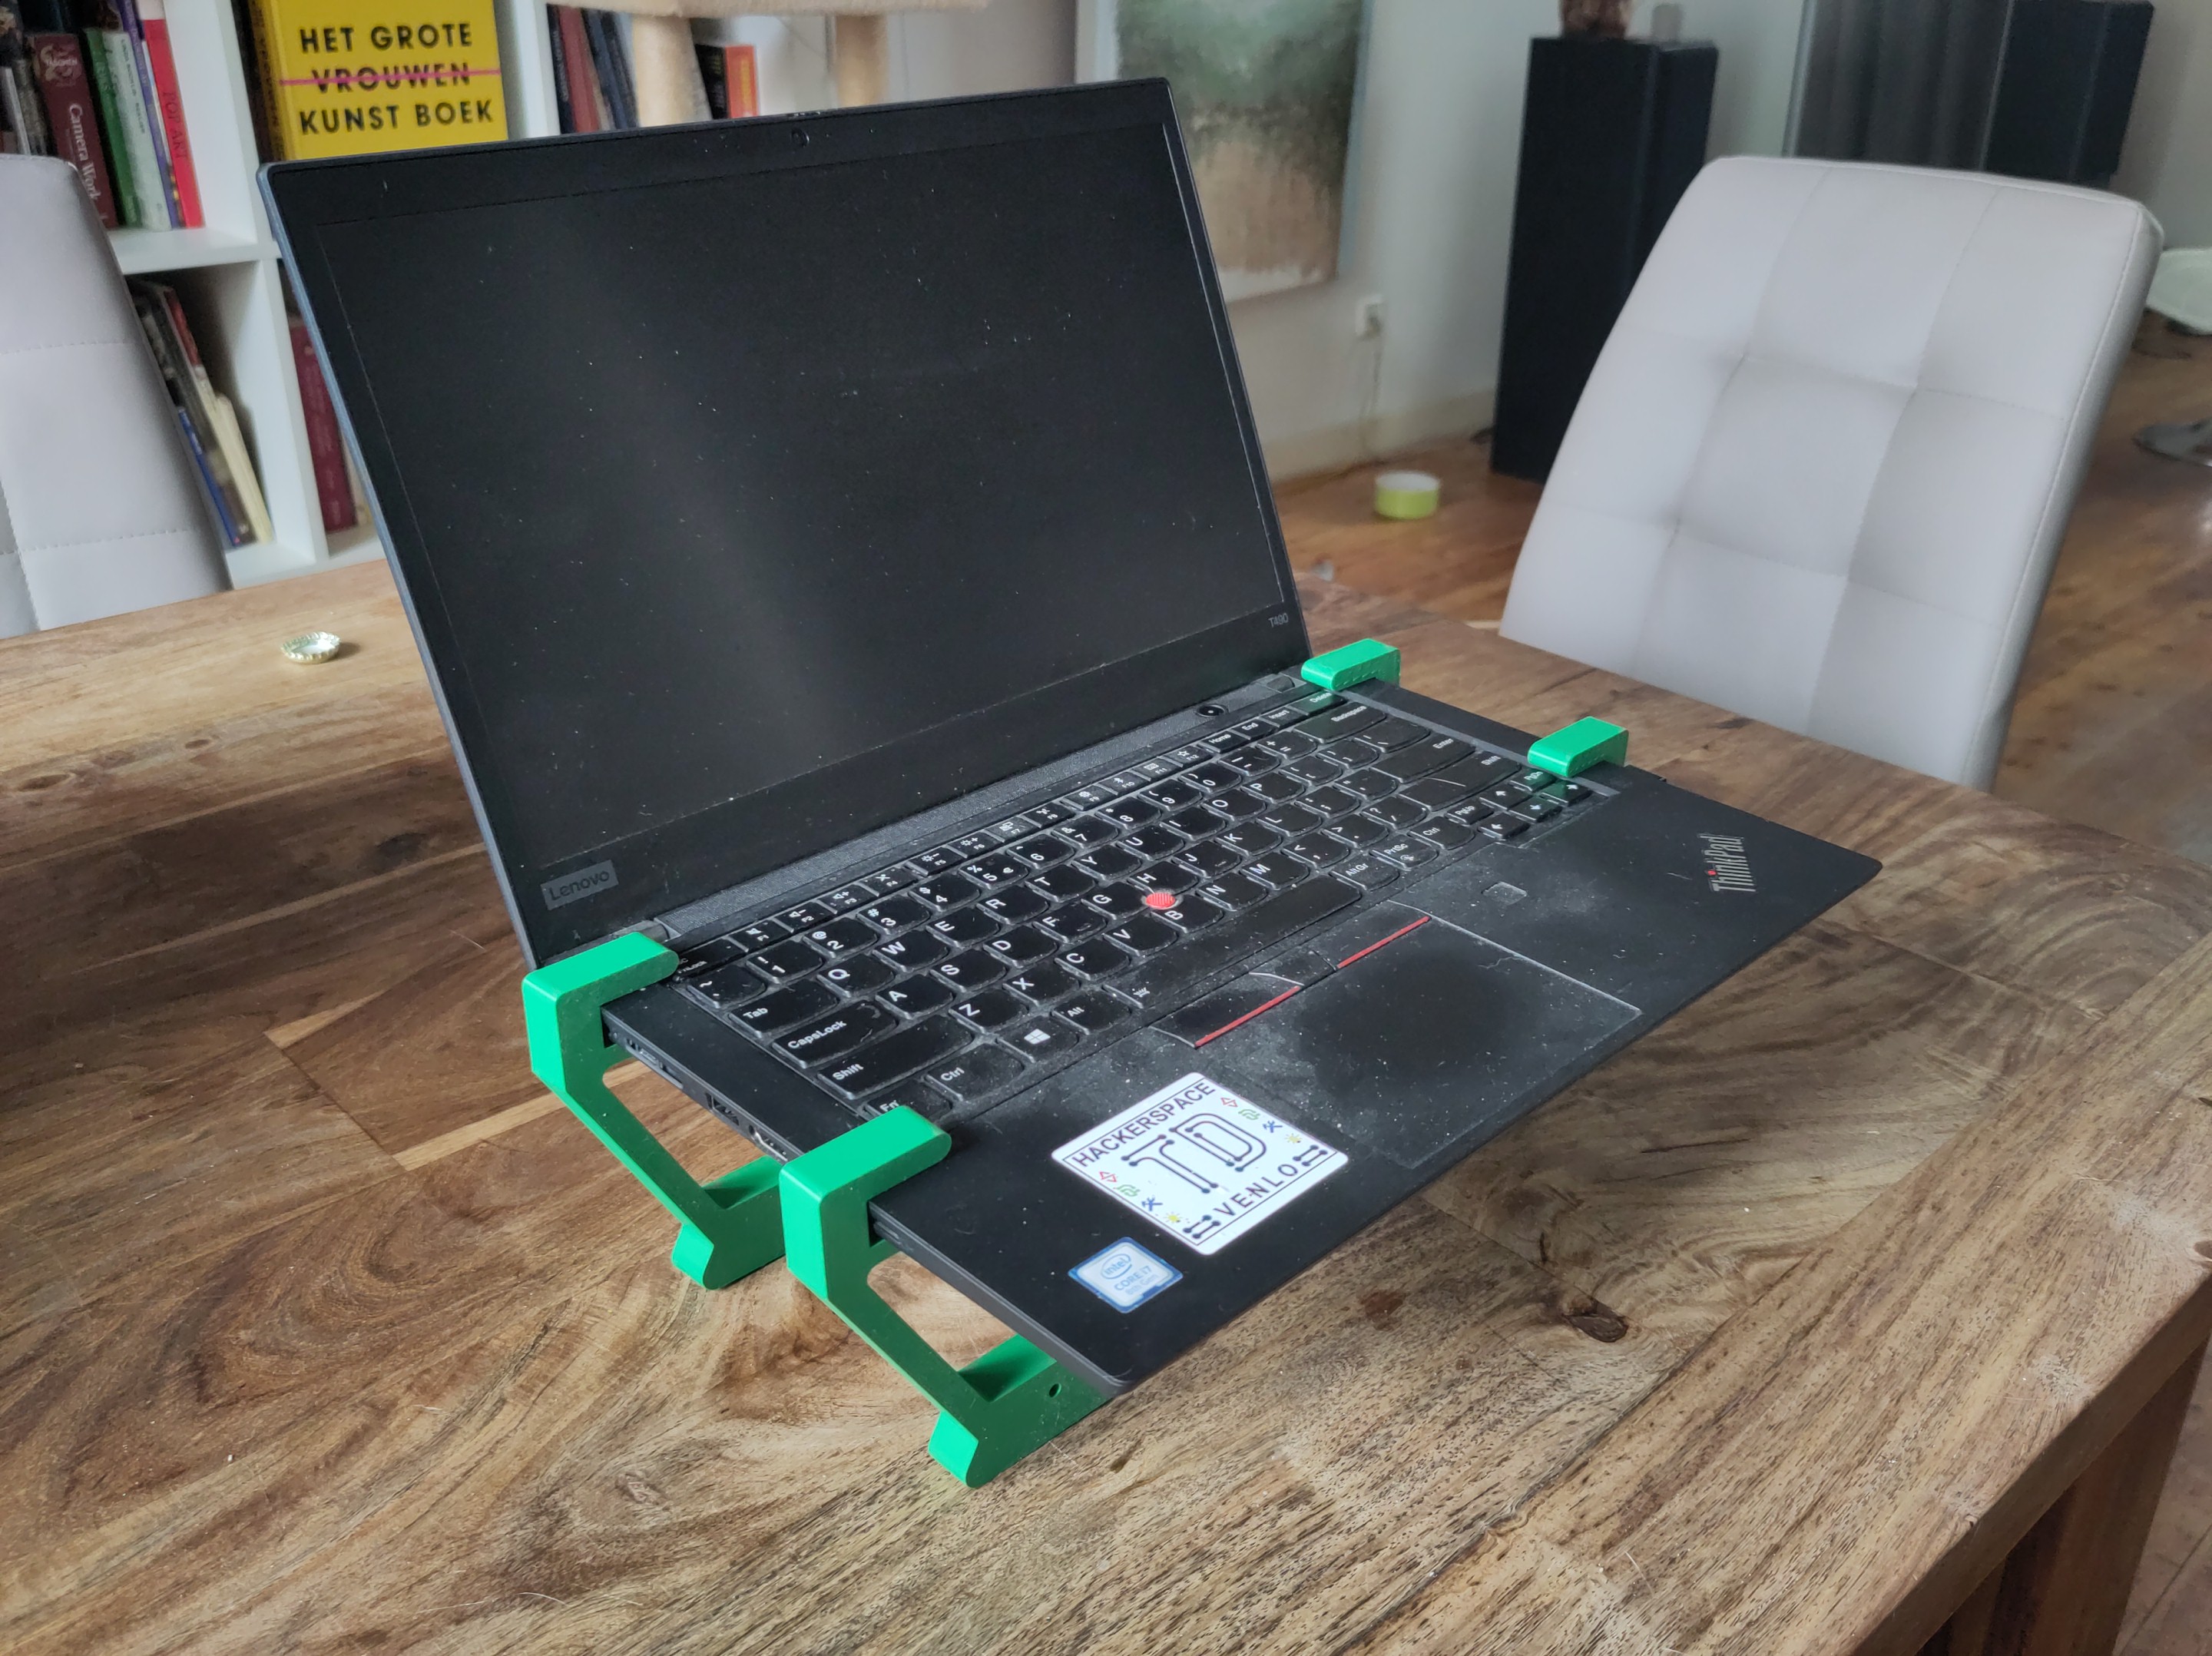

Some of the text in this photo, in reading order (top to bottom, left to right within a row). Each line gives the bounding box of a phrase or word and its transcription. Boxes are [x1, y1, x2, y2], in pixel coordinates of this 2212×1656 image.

[300, 22, 473, 54] HET GROTE
[312, 62, 471, 94] VROUWEN
[162, 91, 180, 123] POP
[300, 99, 494, 135] KUNST BOEK
[69, 103, 89, 161] Camera
[81, 161, 101, 200] Work
[1208, 734, 1232, 744] Home
[1432, 738, 1455, 750] Enter
[1250, 783, 1263, 791] P
[1161, 796, 1176, 805] 9
[1264, 816, 1283, 824] L
[1075, 833, 1088, 842] 7
[1422, 827, 1441, 836] Ctrl
[1125, 836, 1144, 846] U
[1224, 833, 1243, 843] K
[1030, 853, 1045, 862] 6
[1081, 856, 1098, 866] Y
[1184, 853, 1198, 863] J
[1699, 833, 1757, 892] ThinkPad
[966, 865, 983, 873] %
[1249, 863, 1271, 875] M
[1345, 863, 1369, 876] AltGr
[982, 873, 998, 882] 5
[1034, 876, 1051, 886] T
[1137, 873, 1157, 884] H
[548, 870, 610, 901] Lenovo
[1205, 884, 1227, 895] N
[935, 895, 949, 903] 4
[985, 898, 1007, 909] R
[1092, 894, 1112, 905] G
[1164, 910, 1184, 920] B
[880, 917, 896, 926] 3
[935, 920, 955, 932] E
[1041, 916, 1060, 927] F
[812, 930, 827, 940] @
[1112, 929, 1131, 940] V
[826, 940, 844, 951] 2
[881, 941, 906, 955] W
[992, 939, 1012, 951] D
[1066, 952, 1085, 964] C
[772, 965, 786, 974] 1
[827, 968, 851, 980] Q
[940, 964, 960, 975] S
[1012, 977, 1035, 991] X
[888, 990, 908, 1002] A
[743, 1007, 769, 1019] Tab
[958, 1003, 981, 1017] Z
[1067, 1006, 1085, 1018] Alt
[787, 1020, 847, 1049] CapsLock
[833, 1063, 865, 1081] Shift
[940, 1067, 965, 1082] Ctrl
[879, 1099, 900, 1112] Fn
[1071, 1081, 1216, 1167] HACKERSPACE
[1213, 1162, 1299, 1219] VENLO
[1103, 1257, 1129, 1276] intel
[1114, 1272, 1143, 1290] CORE
